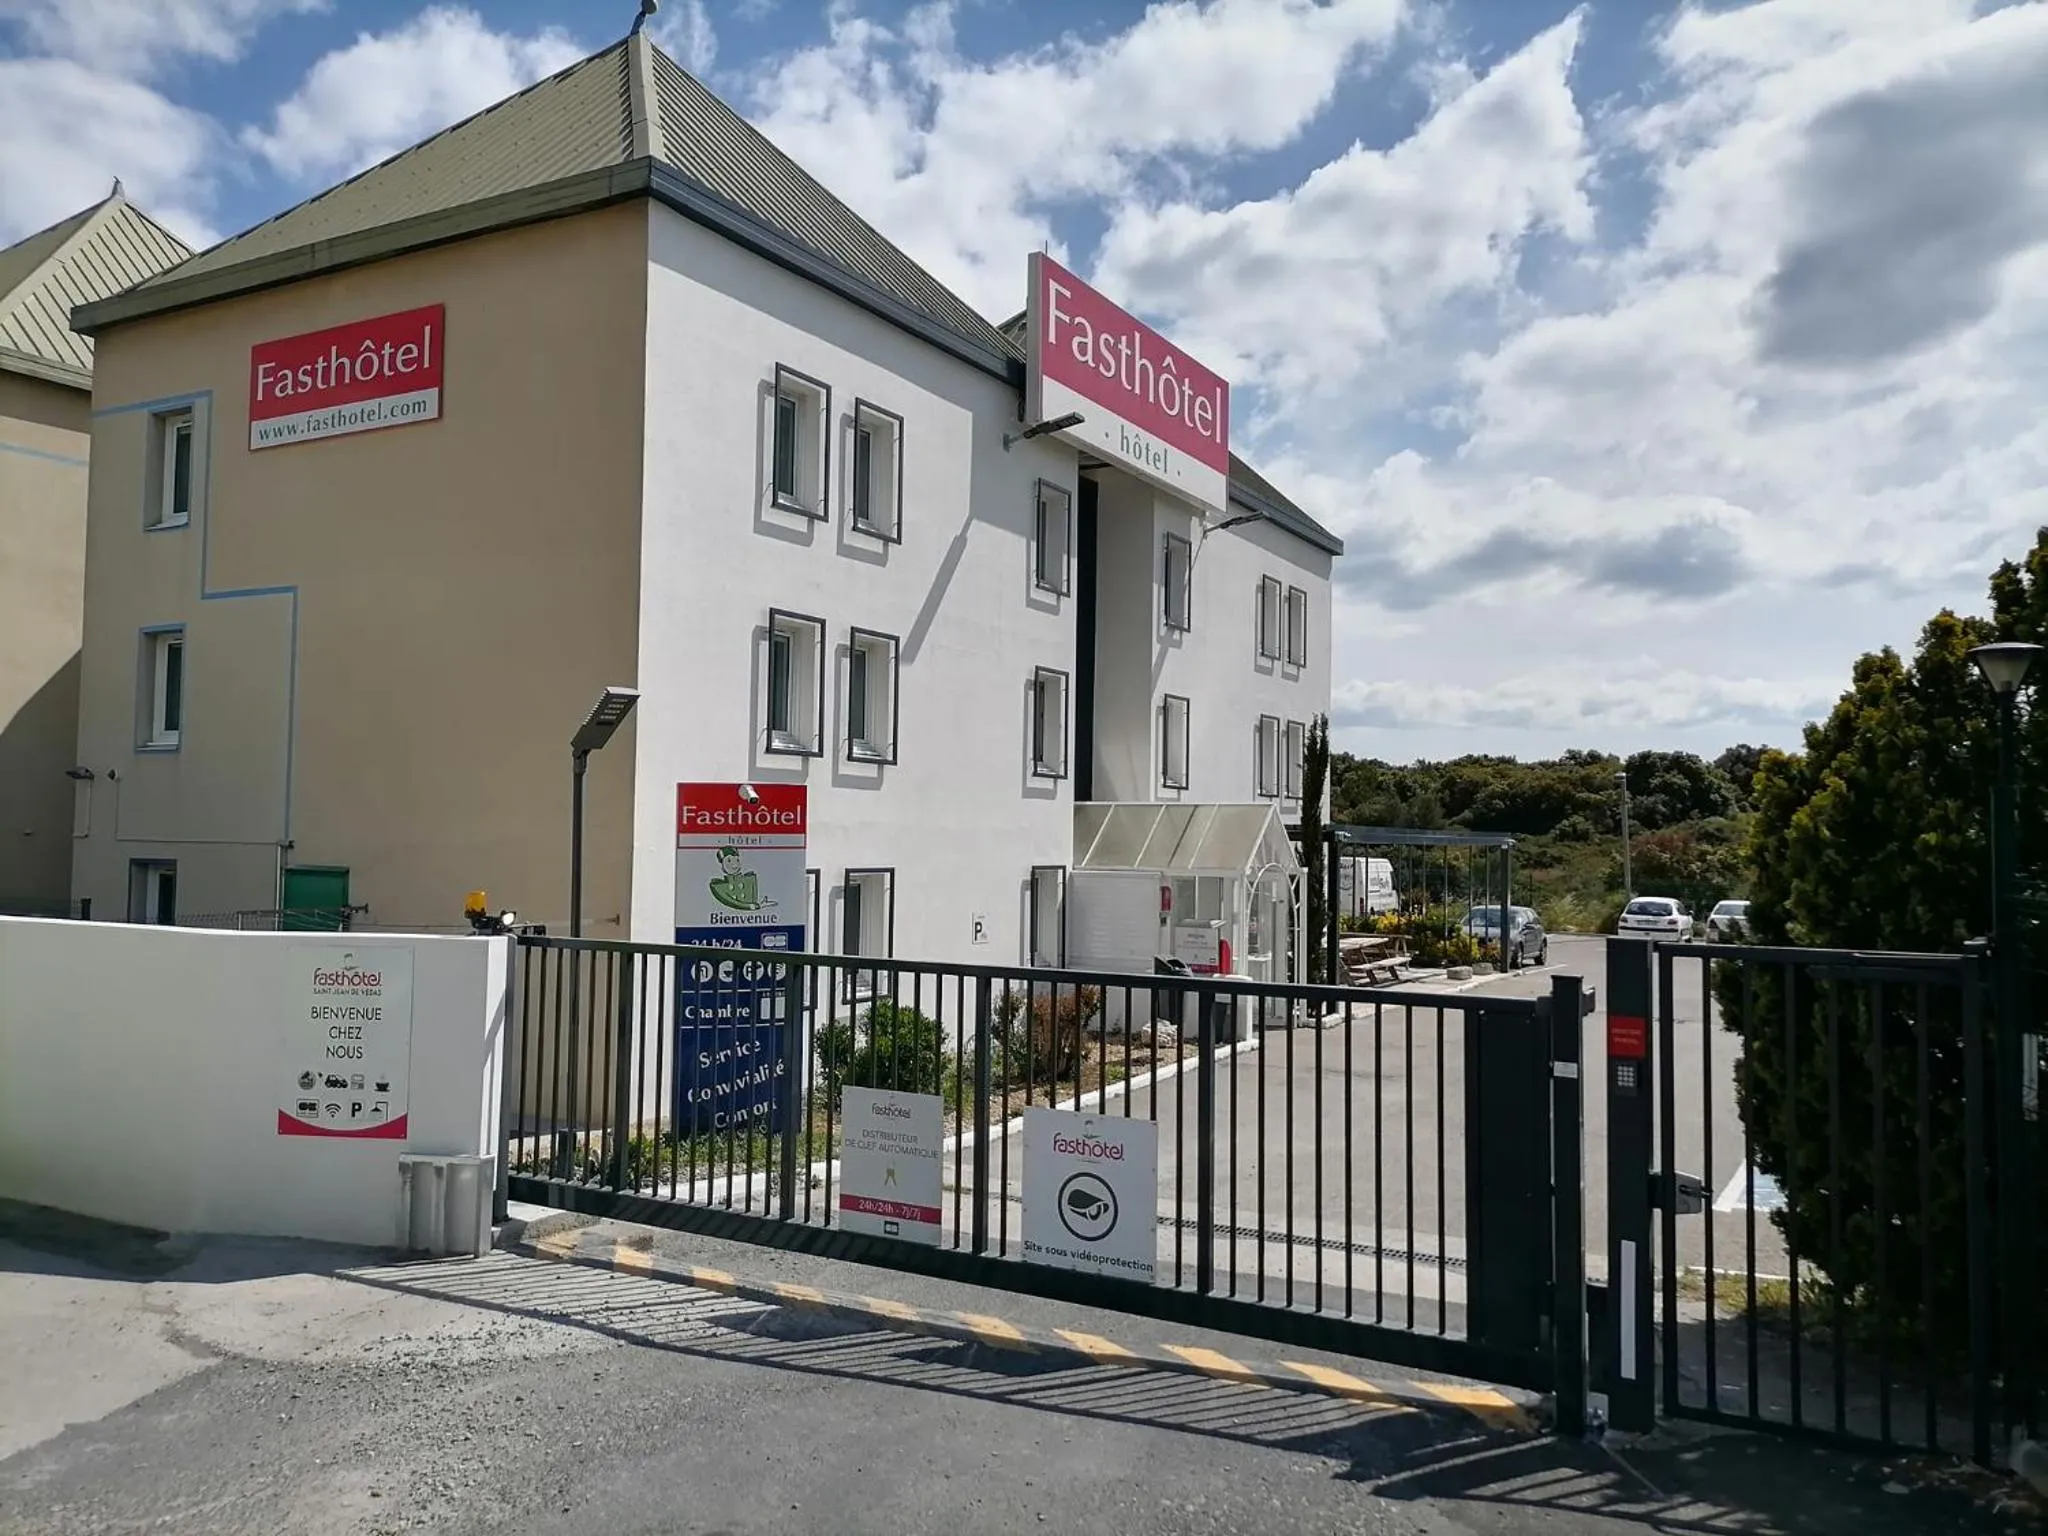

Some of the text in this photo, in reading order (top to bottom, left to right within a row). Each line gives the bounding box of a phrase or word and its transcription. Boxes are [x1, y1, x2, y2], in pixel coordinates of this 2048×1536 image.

[256, 325, 431, 401] Fasthôtel
[1048, 279, 1222, 444] Fasthôtel
[258, 400, 428, 441] www.fasthotel.com
[1120, 424, 1169, 474] hôtel
[682, 804, 801, 825] Fasthôtel
[728, 835, 762, 845] hôtel
[710, 912, 778, 925] Bienvenue
[313, 967, 382, 987] fasthôtel
[310, 1005, 382, 1021] BIENVENUE
[328, 1026, 362, 1040] CHEZ
[325, 1046, 363, 1060] NOUS
[862, 1128, 919, 1145] DISTRIBUTEUR
[1053, 1132, 1123, 1160] fasthôtel
[878, 1142, 940, 1160] AUTOMATIQUE
[1023, 1240, 1154, 1273] Site sous vidéoprotection
